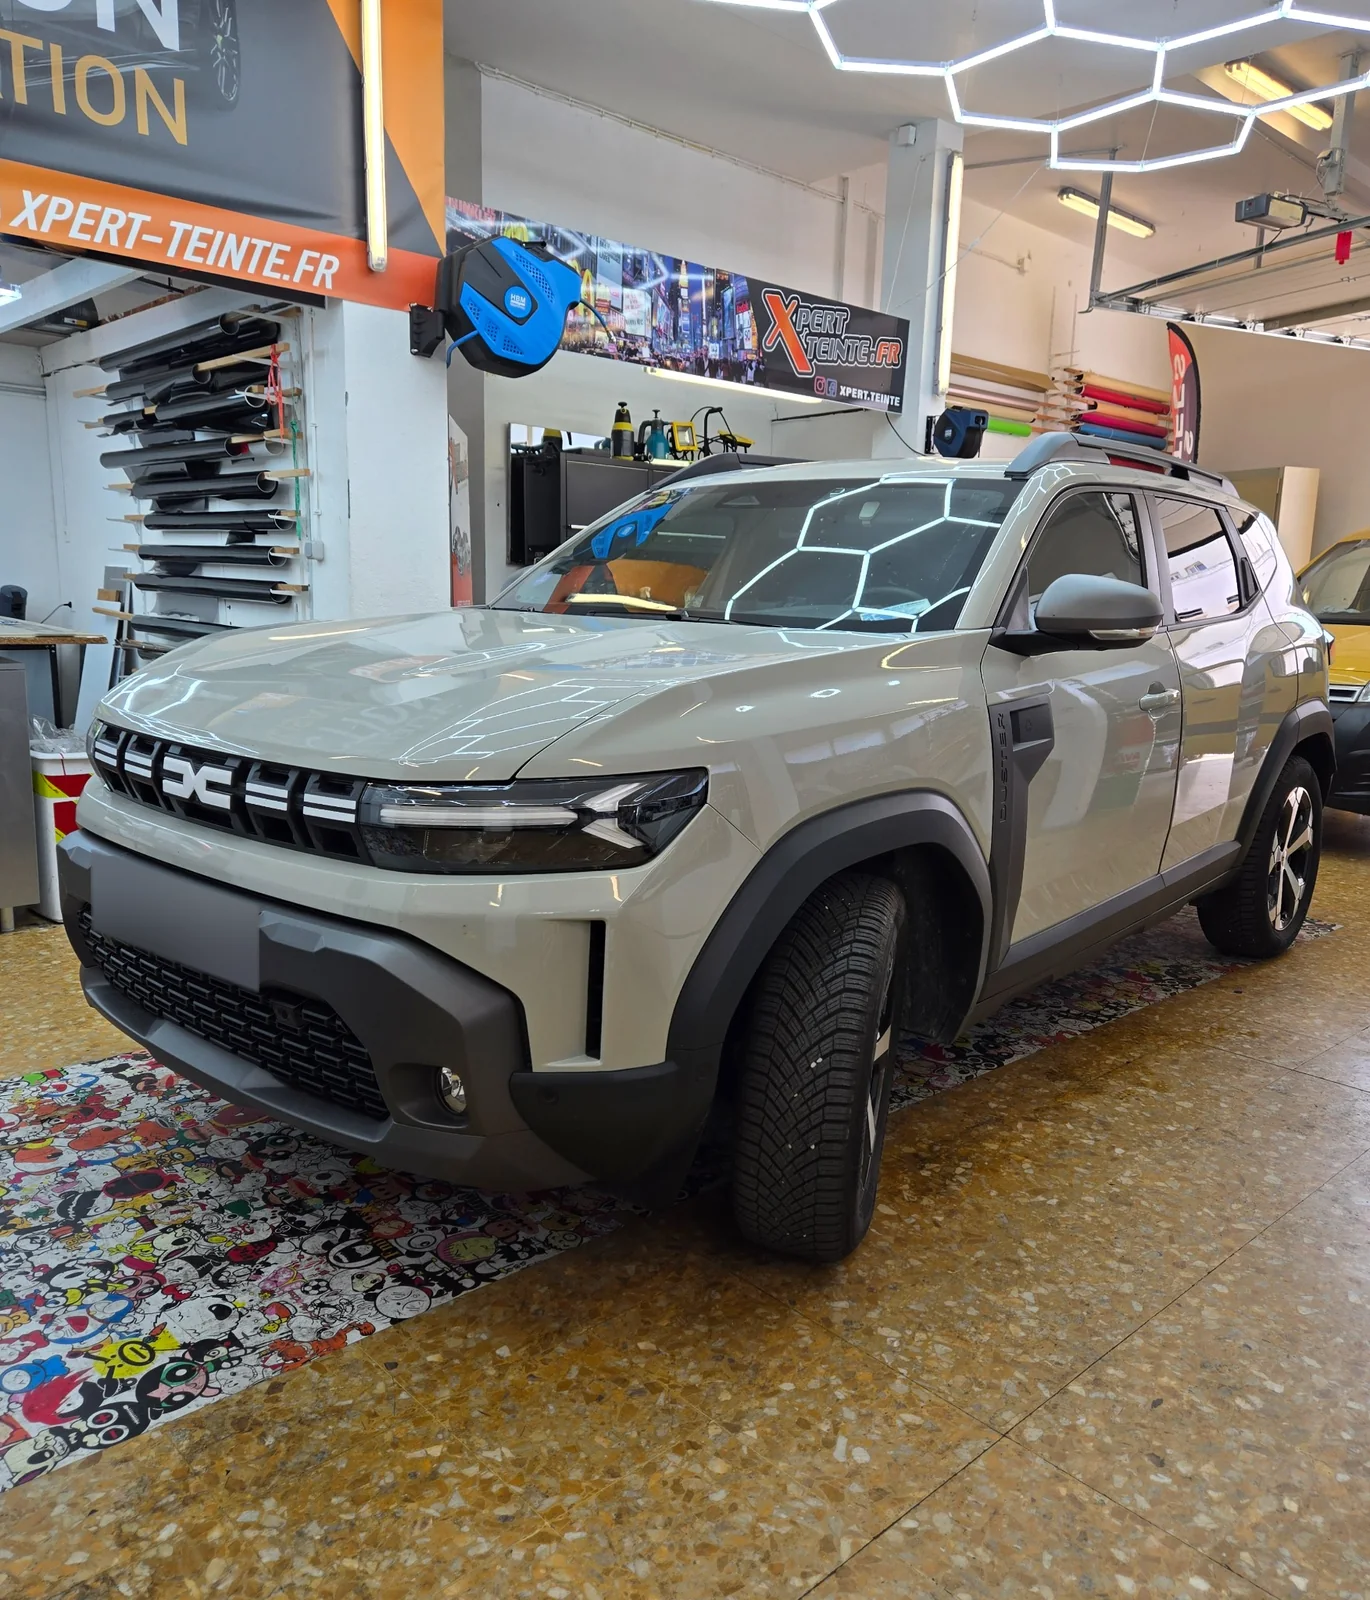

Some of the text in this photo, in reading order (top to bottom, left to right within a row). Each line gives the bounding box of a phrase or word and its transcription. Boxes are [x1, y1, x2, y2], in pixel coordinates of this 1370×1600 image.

[0, 27, 188, 146] TION
[9, 189, 340, 290] XPERT-TEINTE.FR
[510, 293, 526, 304] HBM
[805, 335, 901, 364] TEINTE.FR
[839, 385, 901, 407] XPERT.TEINTE
[997, 712, 1009, 824] DUSTER
